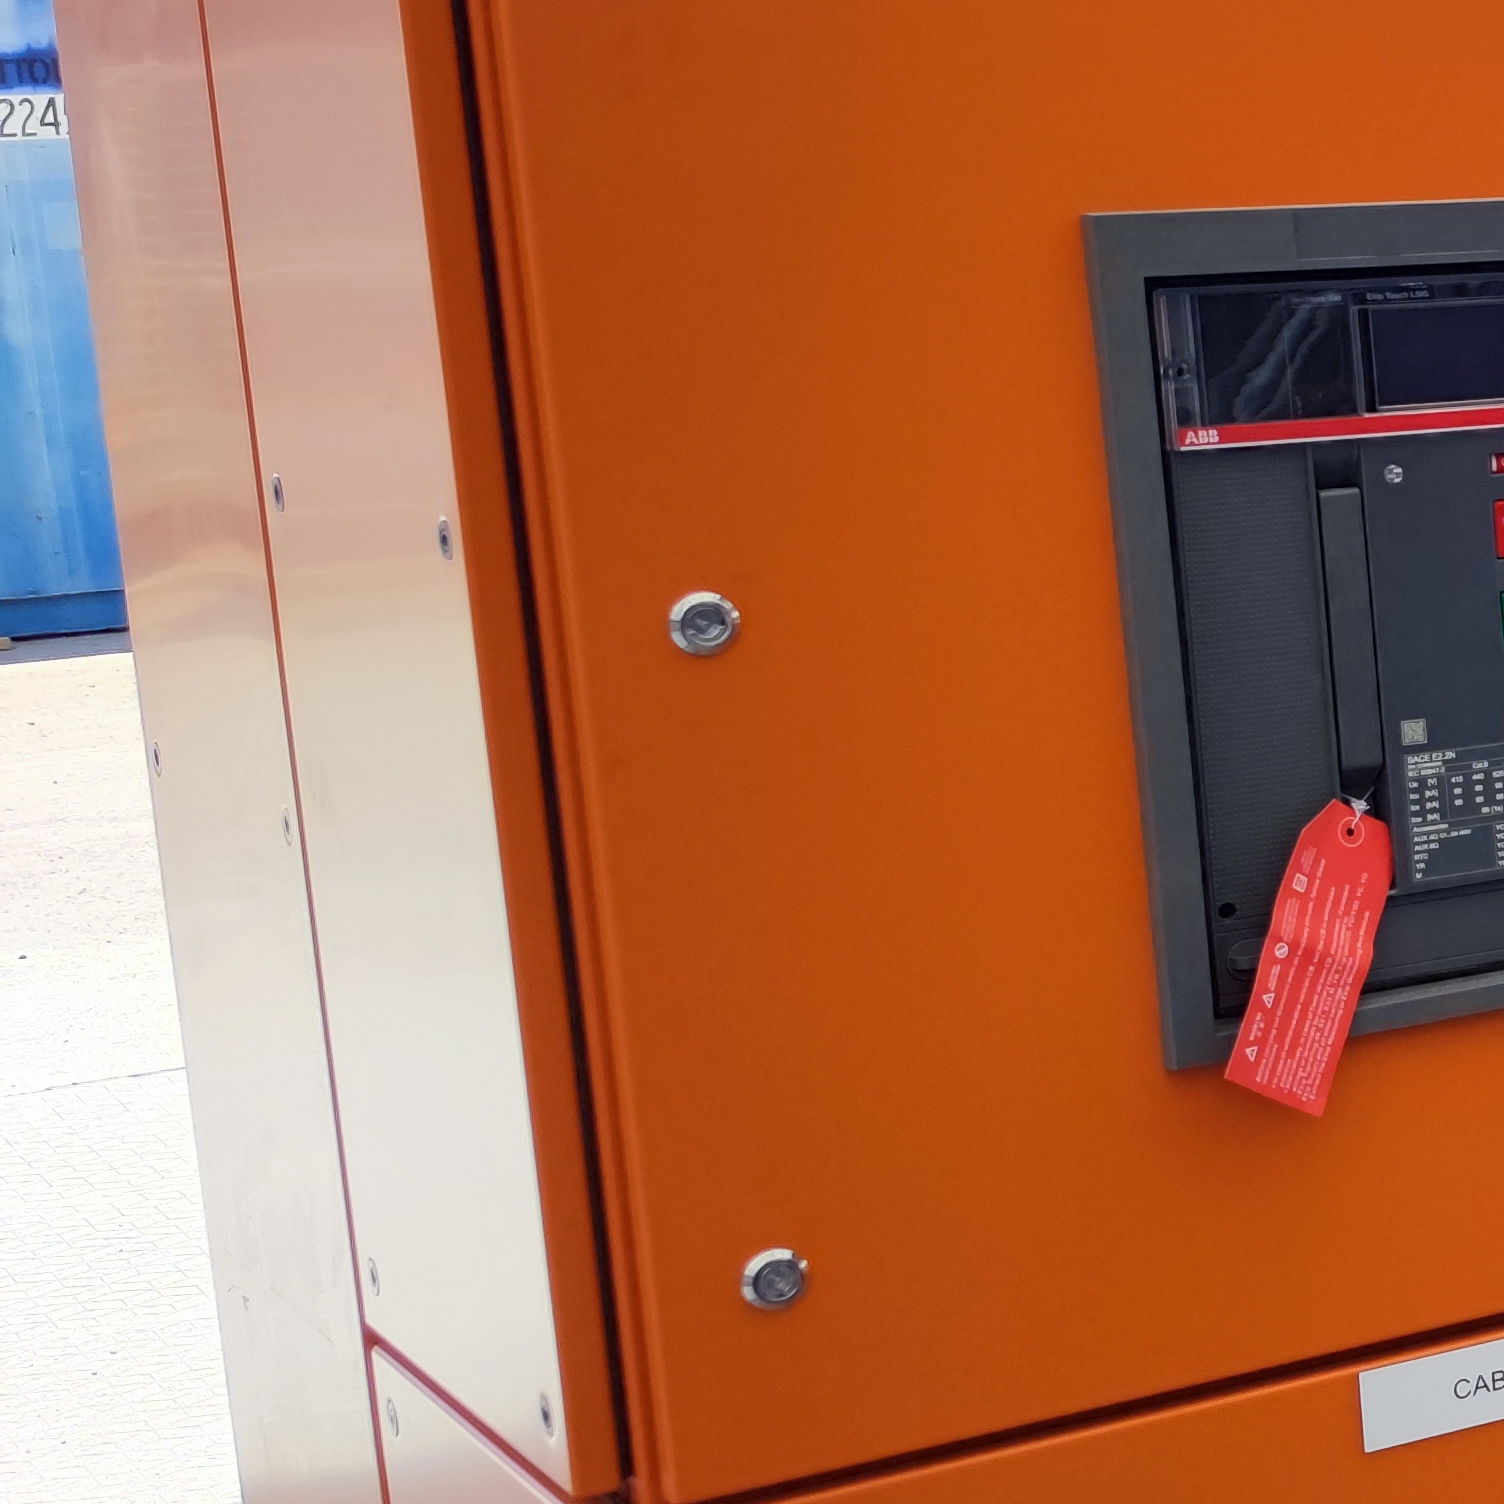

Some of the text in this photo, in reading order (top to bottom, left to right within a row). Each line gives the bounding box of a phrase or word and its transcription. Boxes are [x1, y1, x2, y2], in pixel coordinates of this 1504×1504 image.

[1185, 430, 1220, 446] ABB
[1408, 751, 1456, 763] SACE E2.2N
